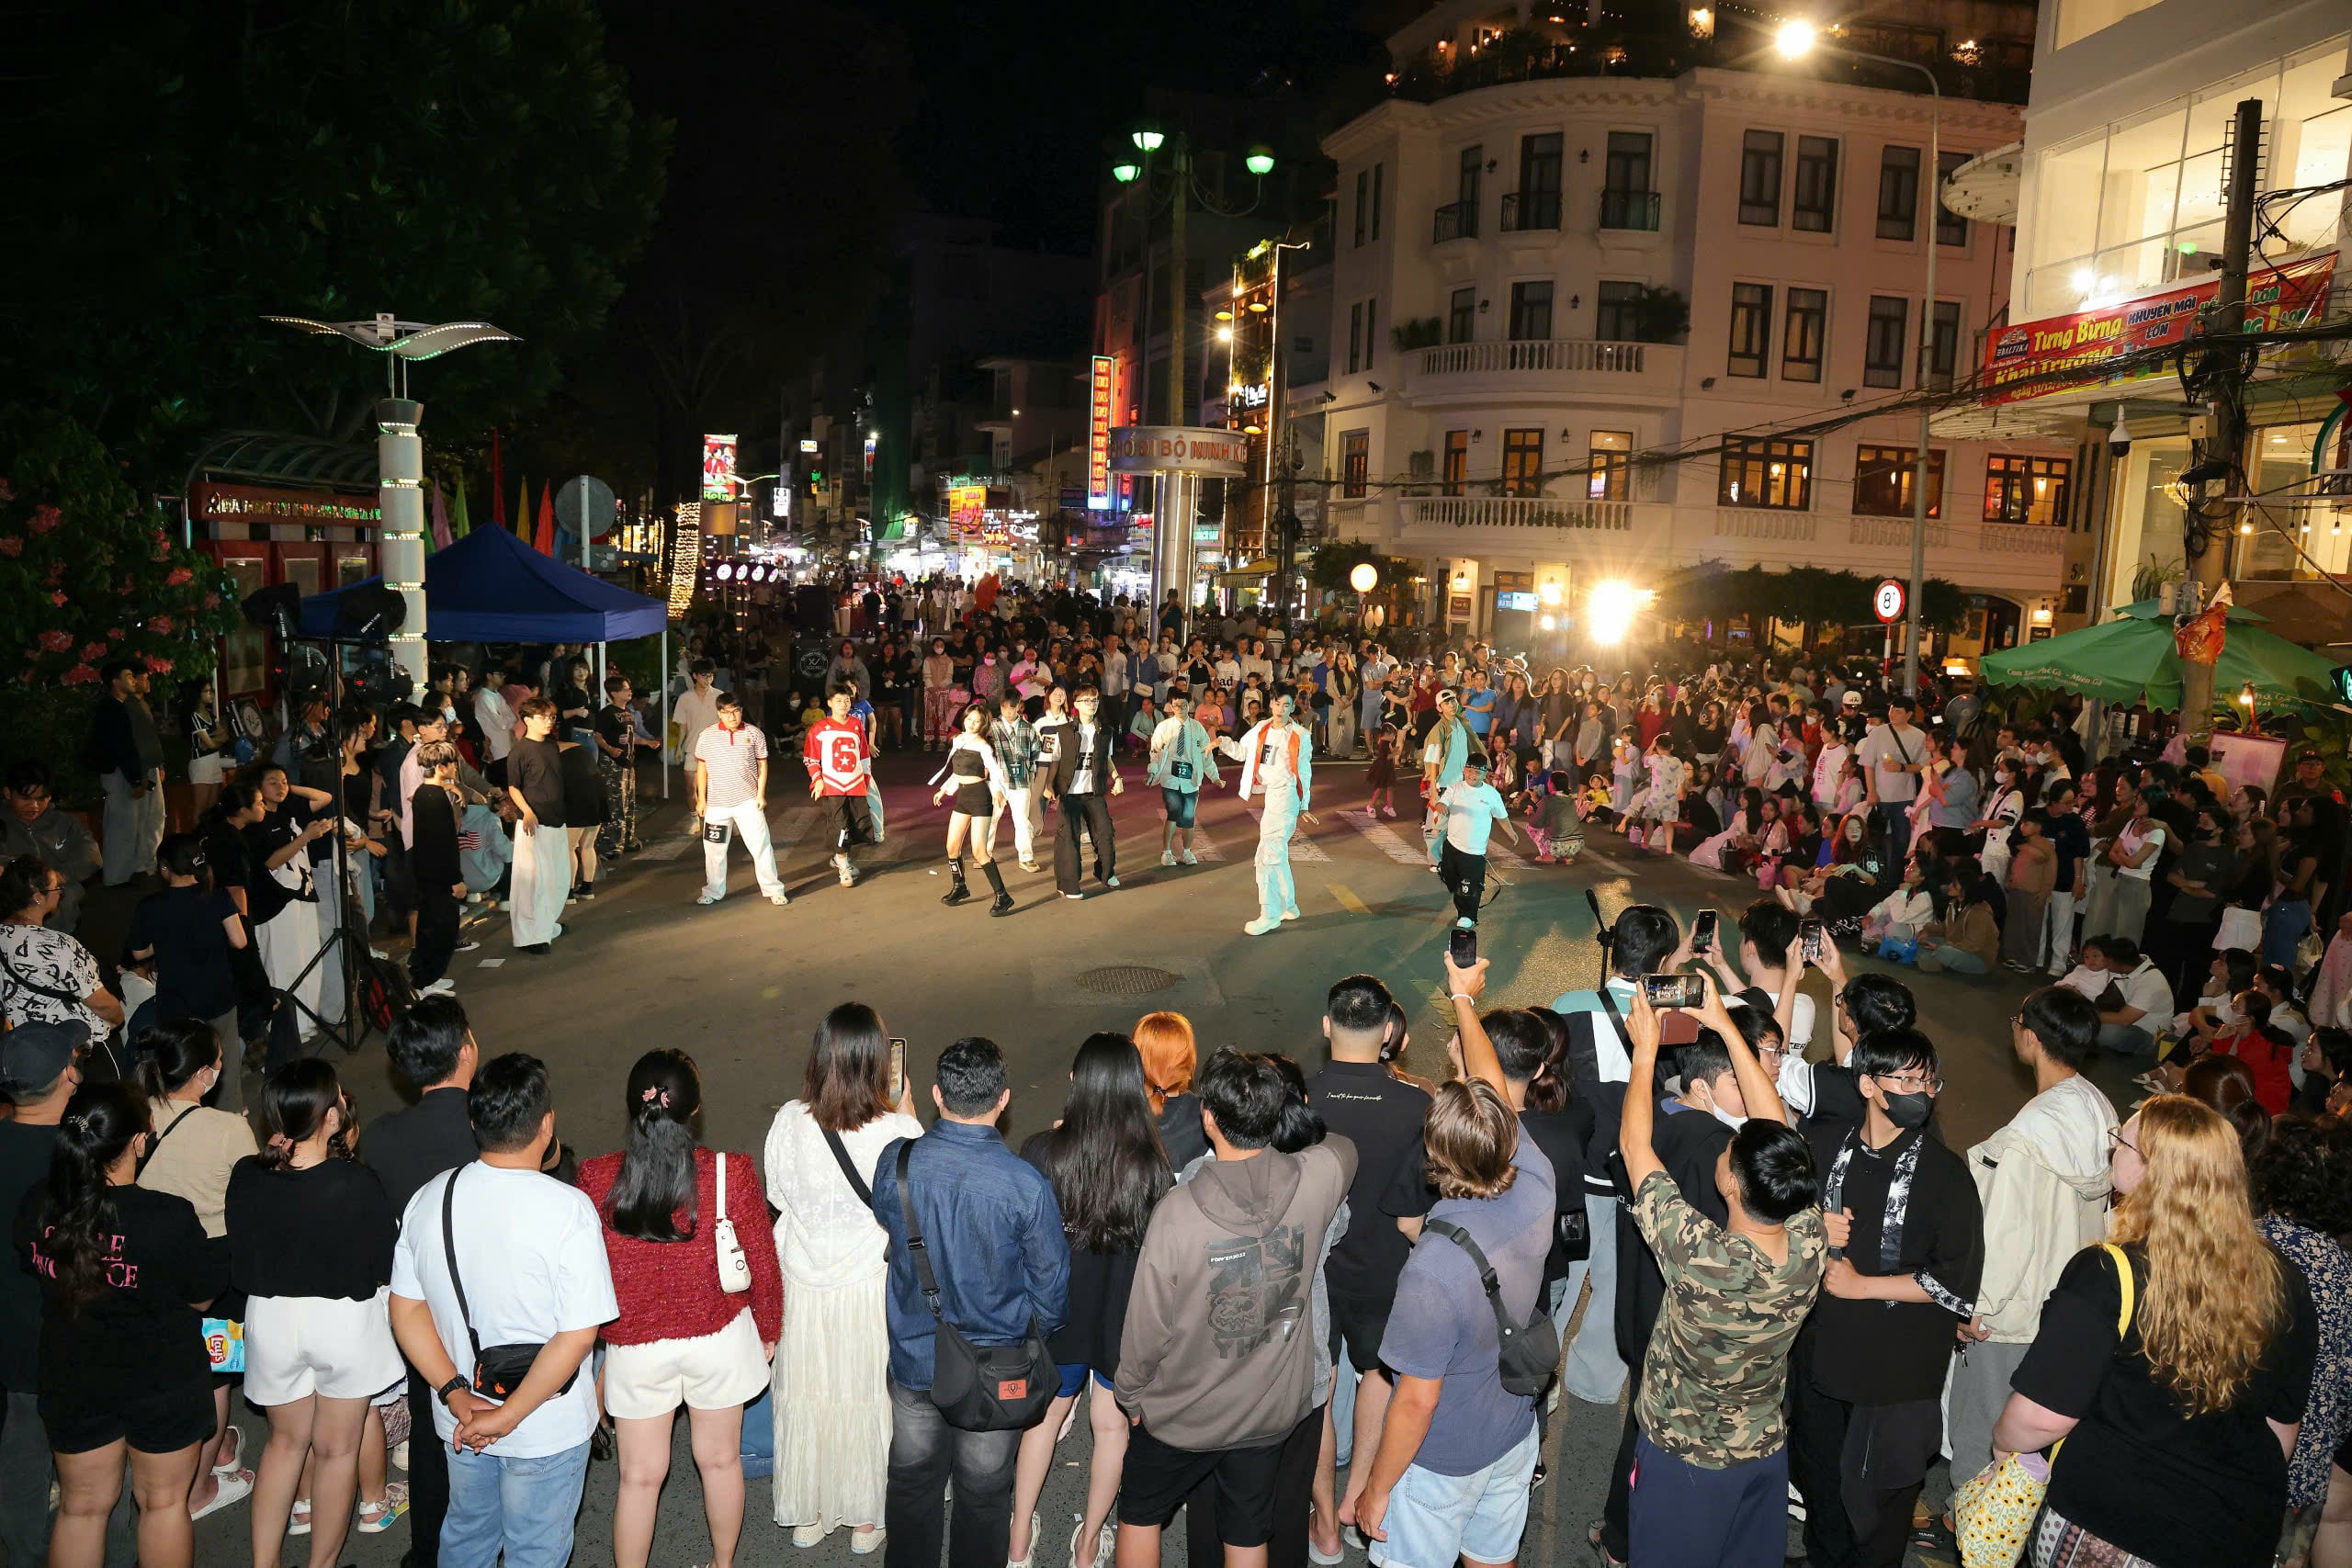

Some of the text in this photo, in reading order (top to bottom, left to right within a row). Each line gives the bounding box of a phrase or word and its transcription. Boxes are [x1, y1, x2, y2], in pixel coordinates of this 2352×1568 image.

[2127, 301, 2172, 326] KHUYẾN
[2033, 315, 2122, 353] Tưng Bừng
[2145, 321, 2169, 341] LỚN
[1093, 361, 1110, 432] THANH
[1160, 434, 1187, 463] BỘ
[1191, 440, 1229, 460] NINH
[1177, 767, 1187, 775] 12
[708, 830, 720, 840] 23
